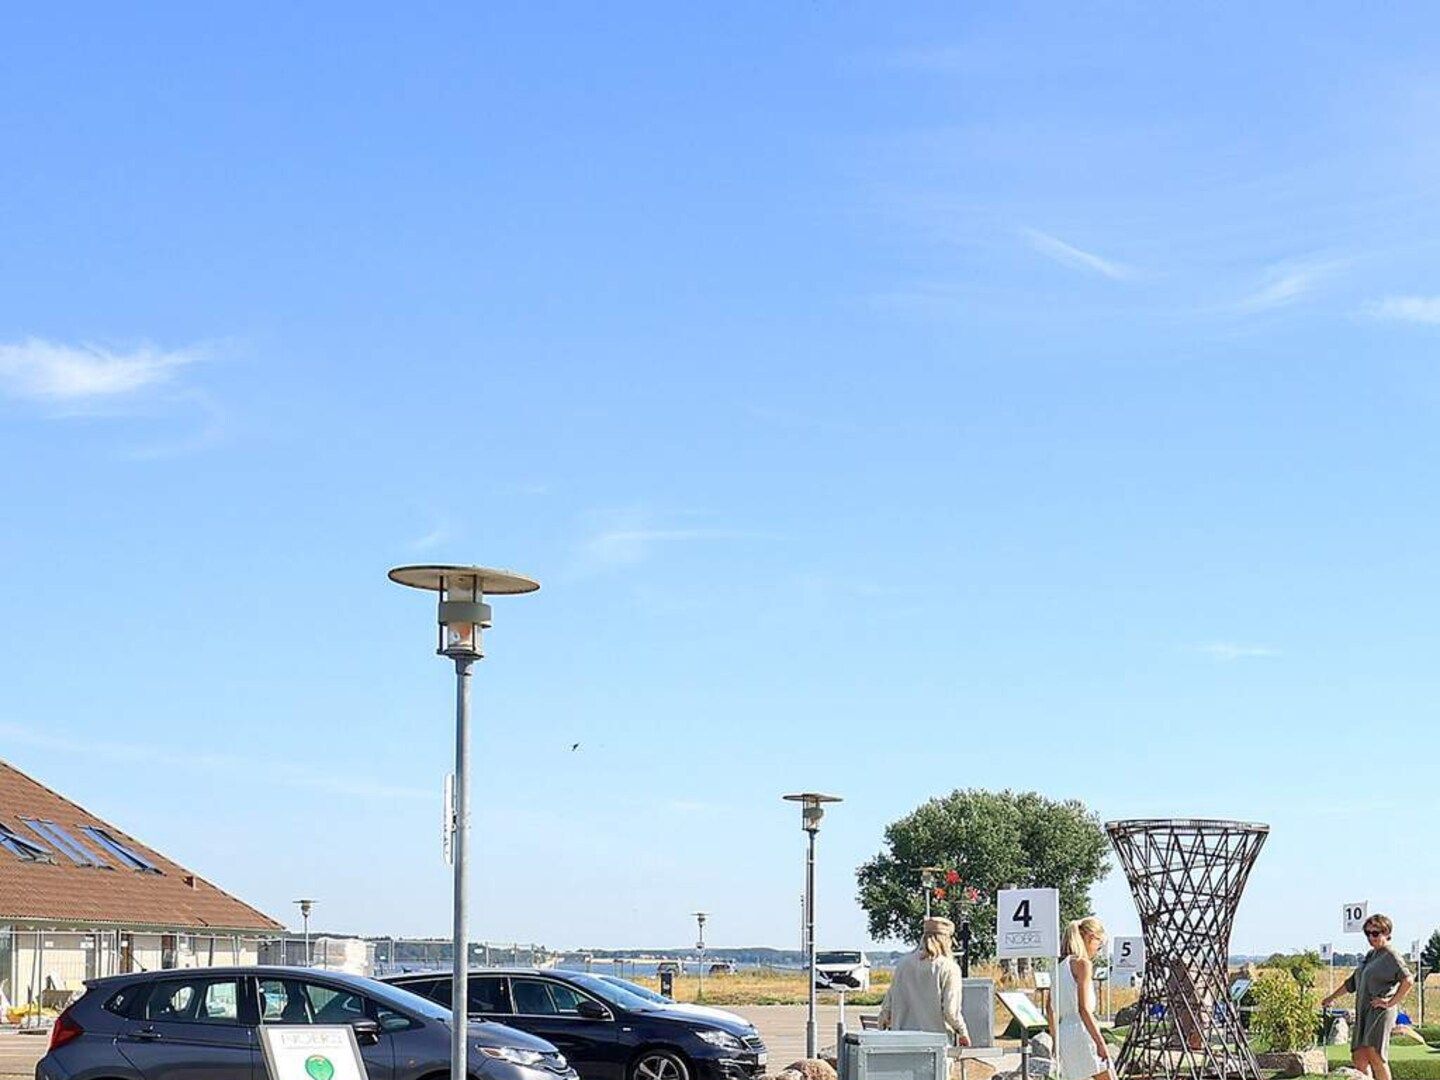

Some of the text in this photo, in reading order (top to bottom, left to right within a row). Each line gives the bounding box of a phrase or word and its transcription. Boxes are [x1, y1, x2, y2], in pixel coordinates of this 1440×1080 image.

[1012, 899, 1033, 928] 4
[1345, 906, 1362, 920] 10
[1121, 941, 1132, 957] 5
